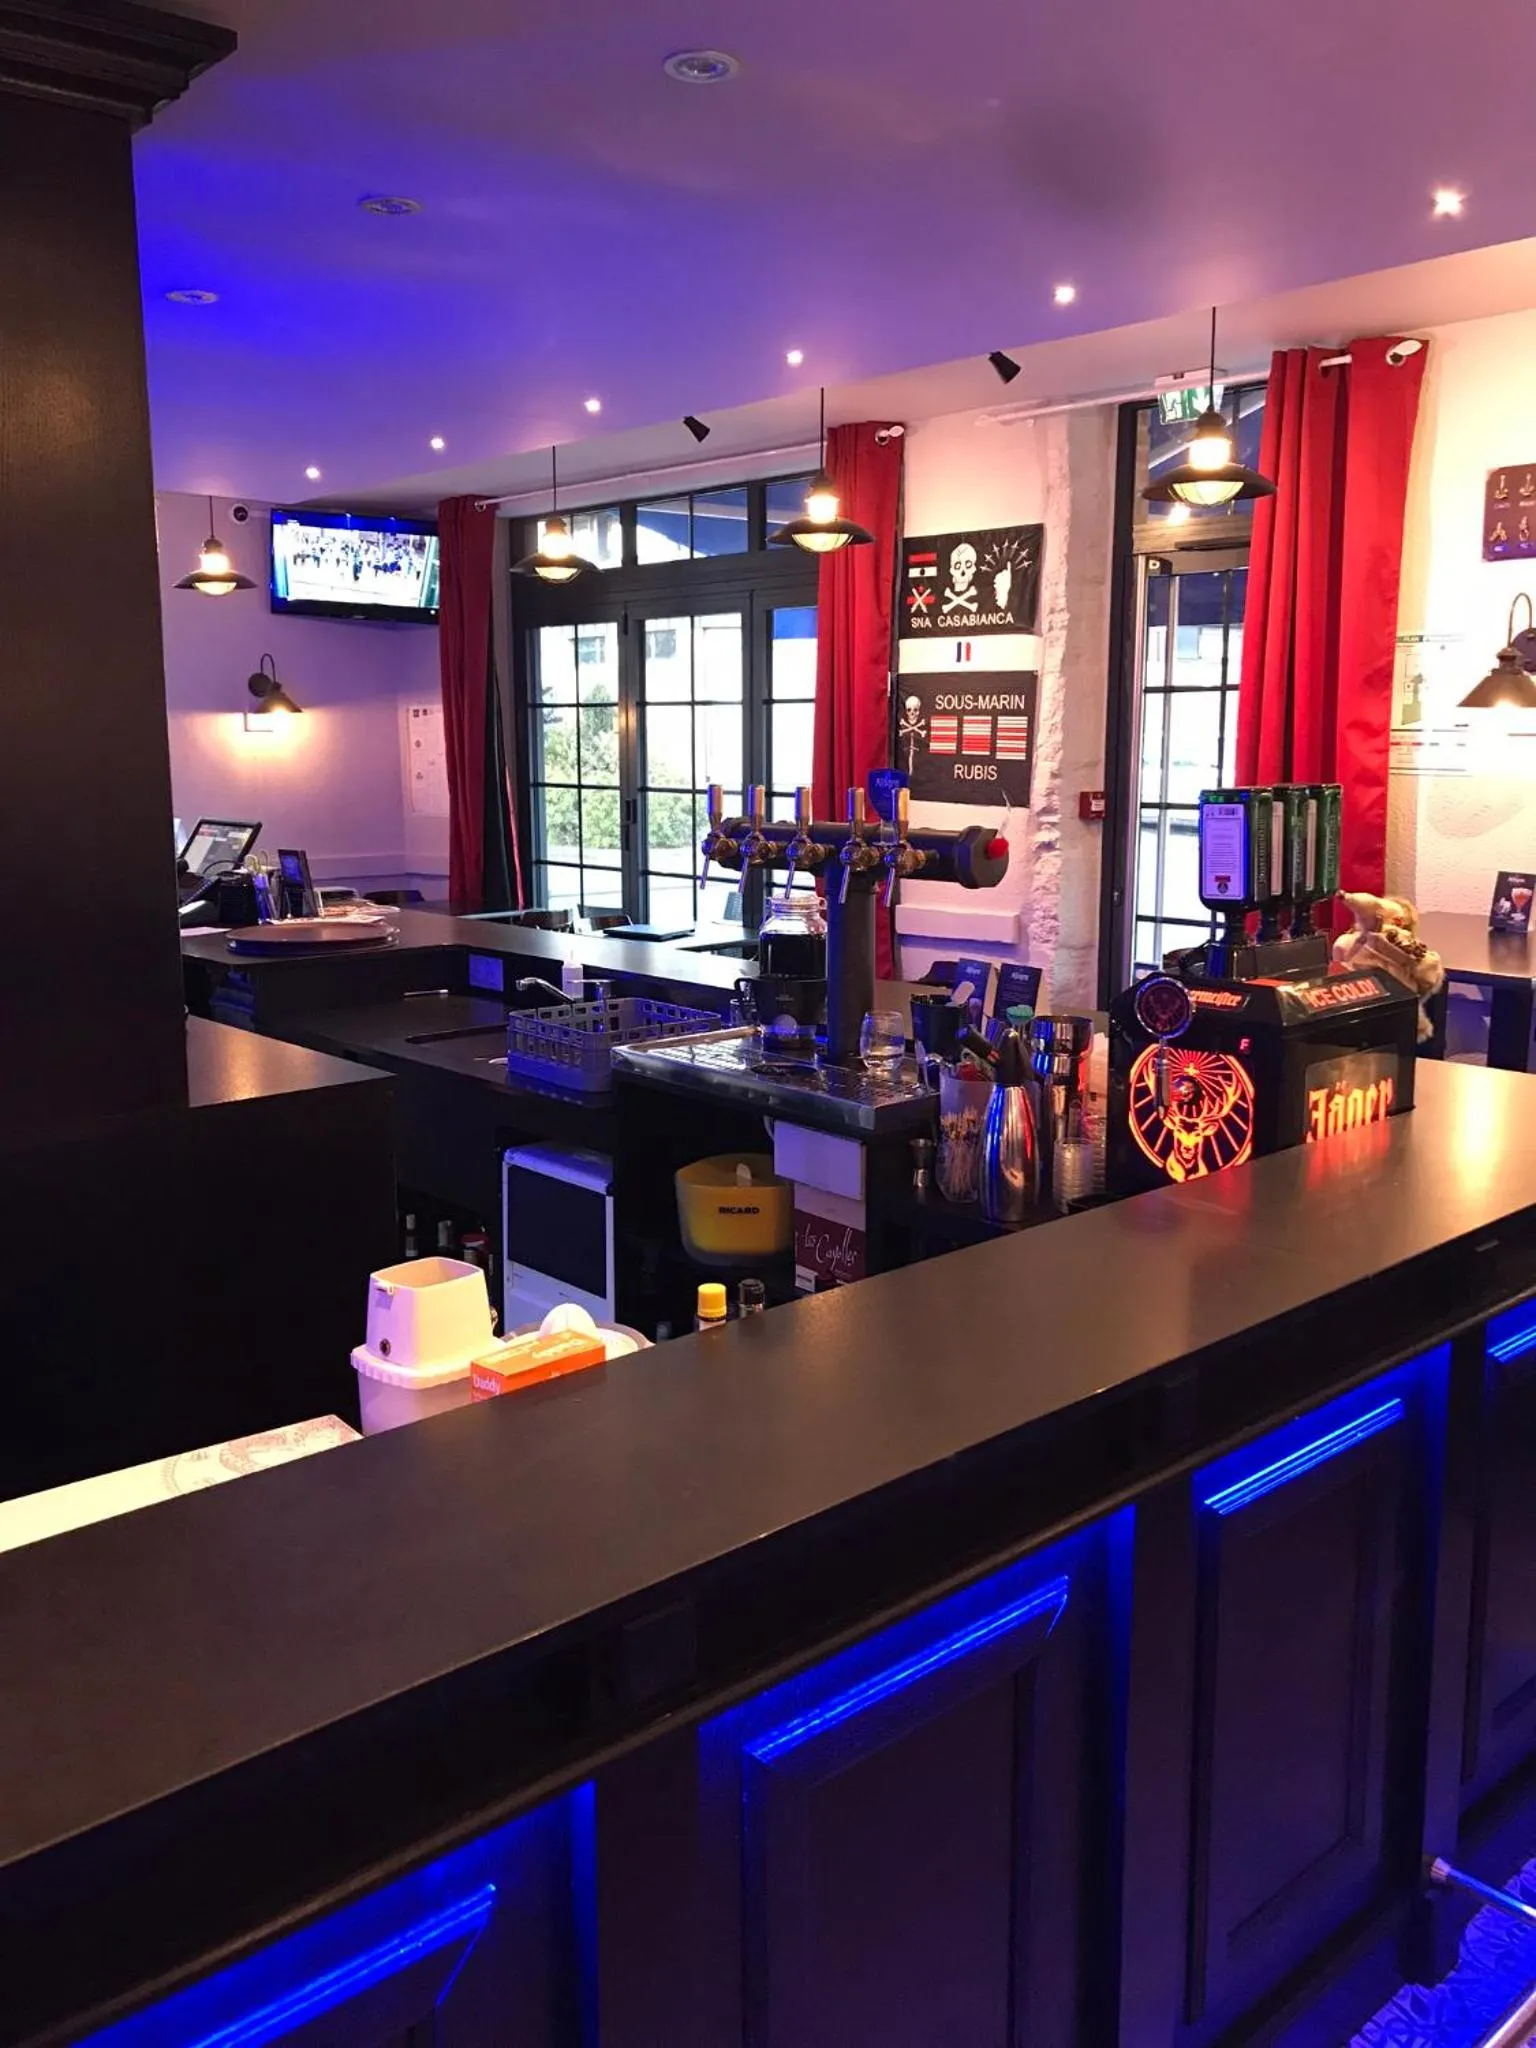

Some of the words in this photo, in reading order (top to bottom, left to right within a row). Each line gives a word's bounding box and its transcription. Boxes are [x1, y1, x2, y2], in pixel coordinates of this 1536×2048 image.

[911, 616, 932, 628] SNA
[937, 612, 1014, 627] CASABIANCA
[935, 694, 1025, 710] SOUS-MARIN
[953, 764, 998, 780] RUBIS
[1304, 988, 1337, 1008] ICE
[718, 1206, 760, 1214] RICARD
